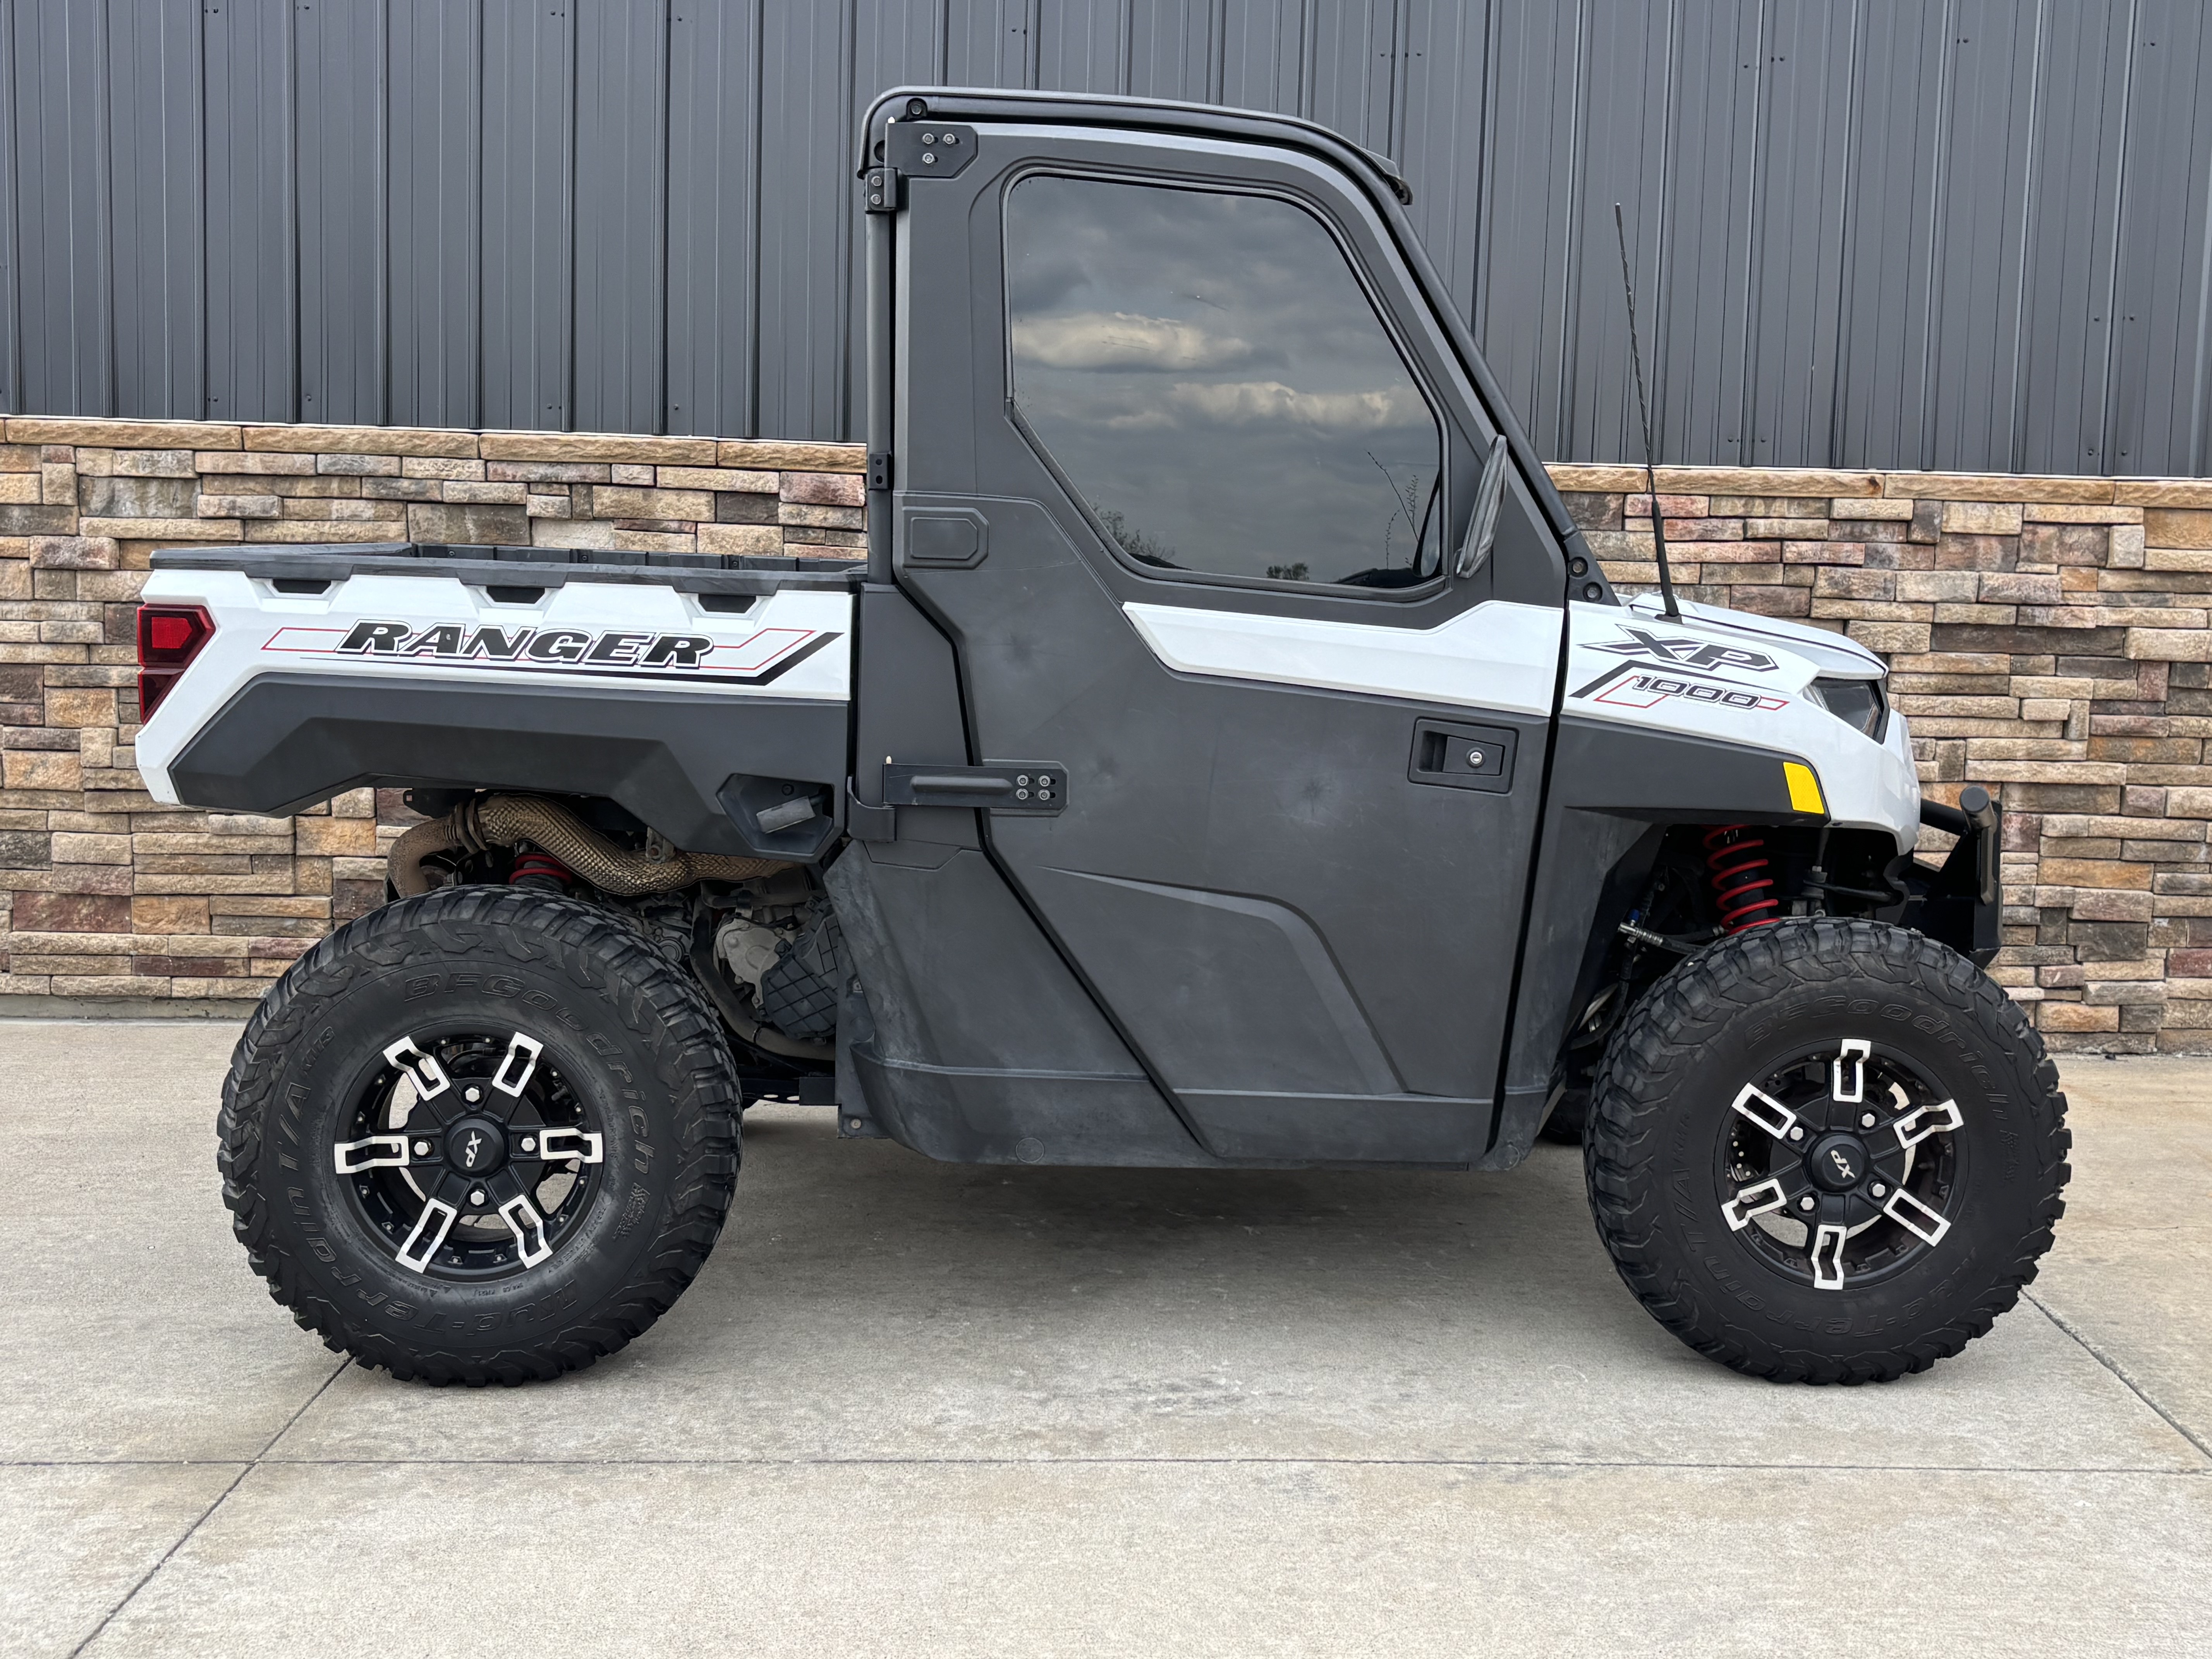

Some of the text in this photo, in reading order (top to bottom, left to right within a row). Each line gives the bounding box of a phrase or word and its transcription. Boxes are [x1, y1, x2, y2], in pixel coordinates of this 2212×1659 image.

[335, 618, 715, 669] RANGER
[1578, 624, 1780, 672] XP
[1632, 674, 1762, 709] 1000
[404, 972, 655, 1174] BFGoodrich
[465, 1131, 482, 1167] XP
[1830, 1149, 1856, 1179] XP
